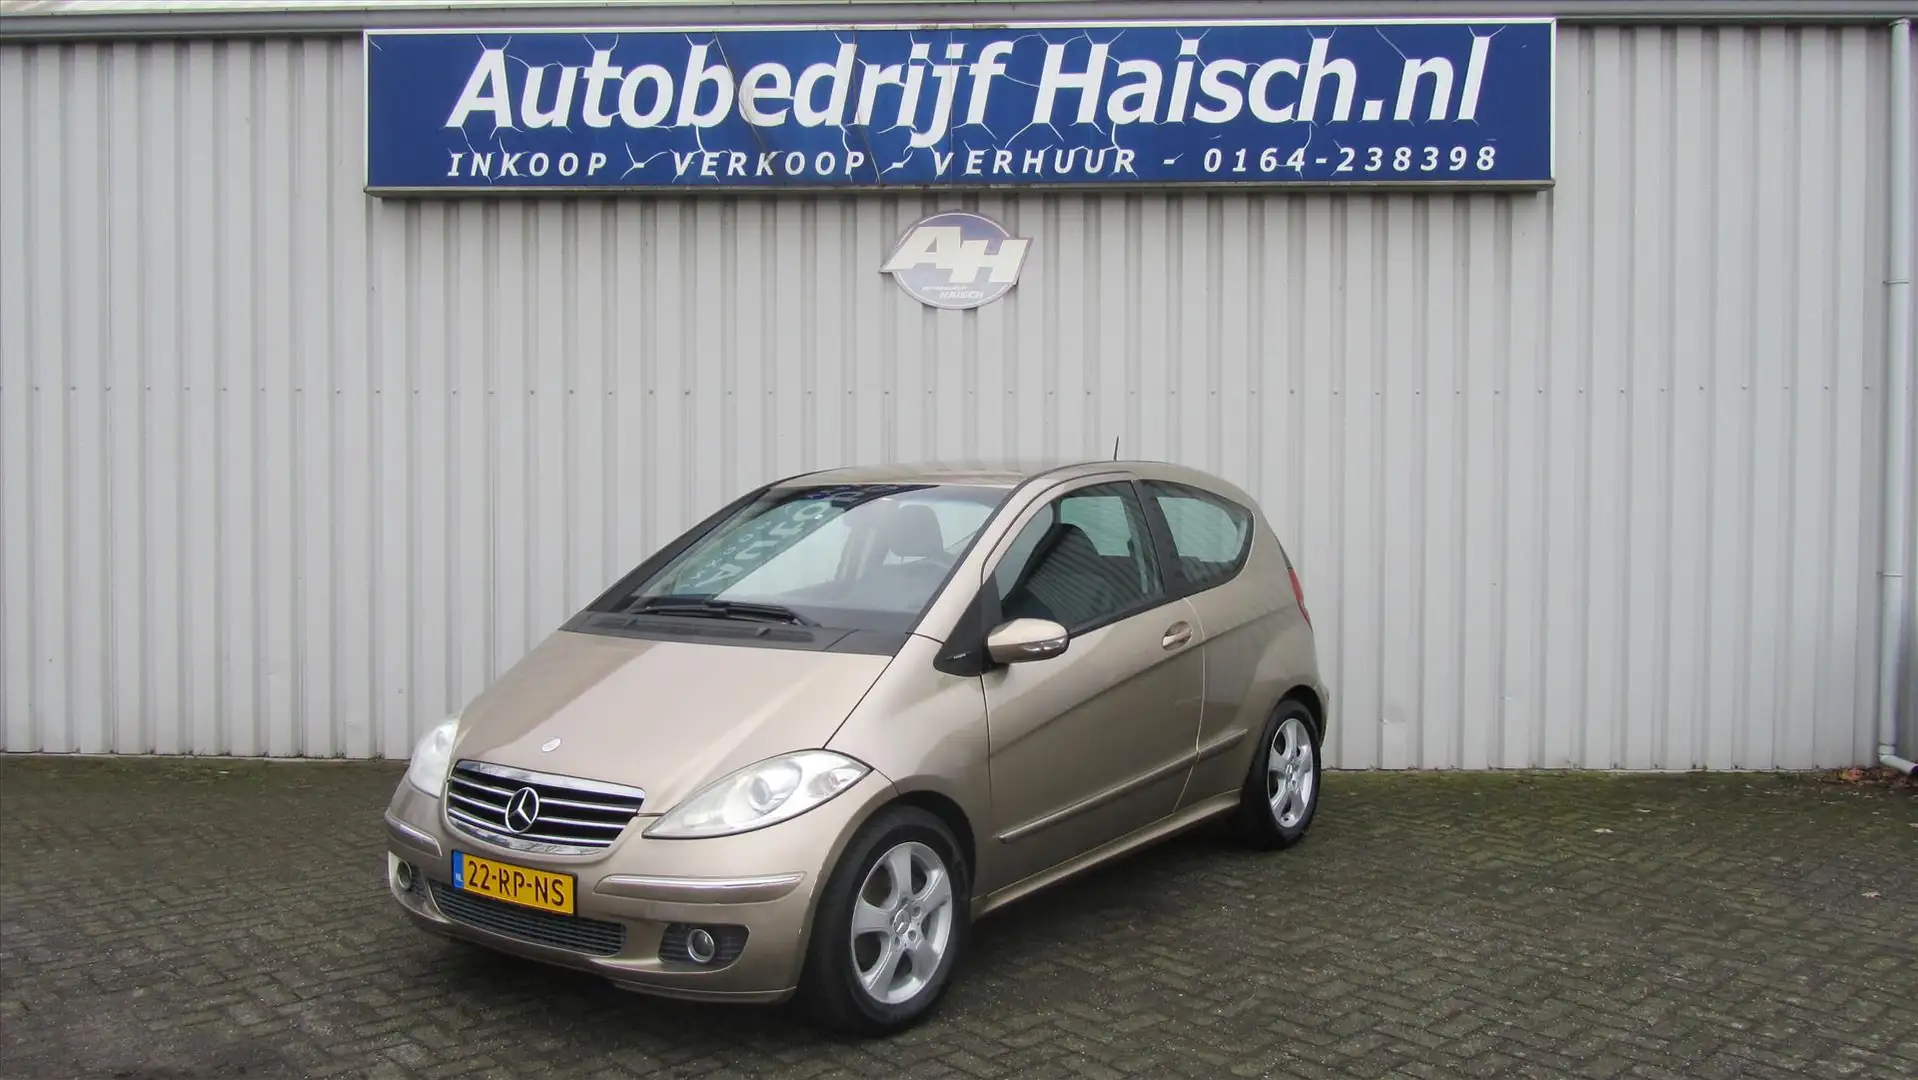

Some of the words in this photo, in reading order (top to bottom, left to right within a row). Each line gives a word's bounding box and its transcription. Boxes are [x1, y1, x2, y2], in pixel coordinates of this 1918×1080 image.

[446, 40, 1013, 148] Autobedrijf
[1031, 36, 1492, 125] Haisch.nl
[447, 152, 607, 177] INKOOP
[674, 150, 866, 177] VERKOOP
[933, 148, 1135, 177] VERHUUR
[1203, 146, 1496, 173] 0164-238398
[883, 226, 1029, 283] AH
[455, 873, 463, 882] NL
[468, 860, 565, 907] 22-RP-NS
